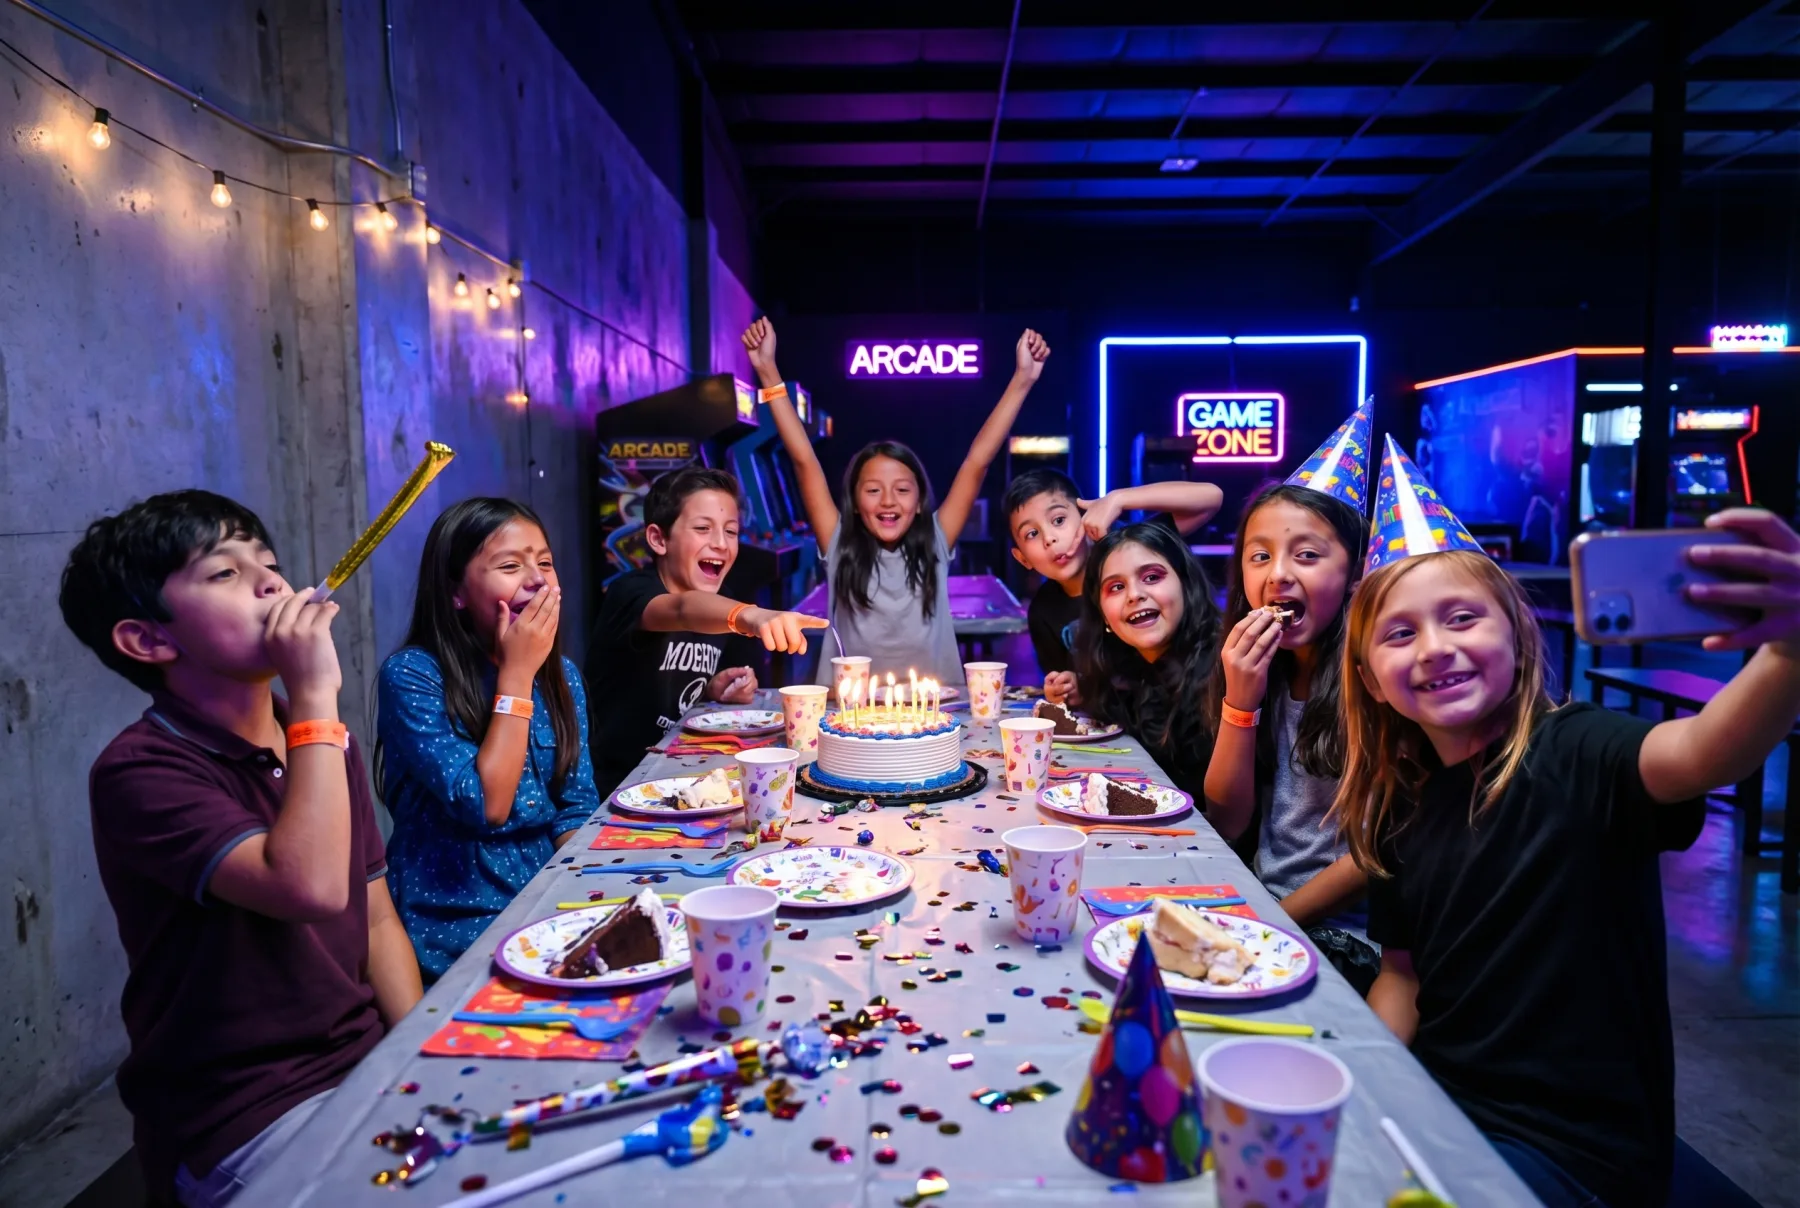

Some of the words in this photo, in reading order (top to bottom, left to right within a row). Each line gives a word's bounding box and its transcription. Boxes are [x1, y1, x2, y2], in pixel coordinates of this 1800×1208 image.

[849, 344, 979, 375] ARCADE
[1188, 400, 1274, 429] GAME
[608, 442, 691, 458] ARCADE
[1191, 428, 1273, 456] ZONE
